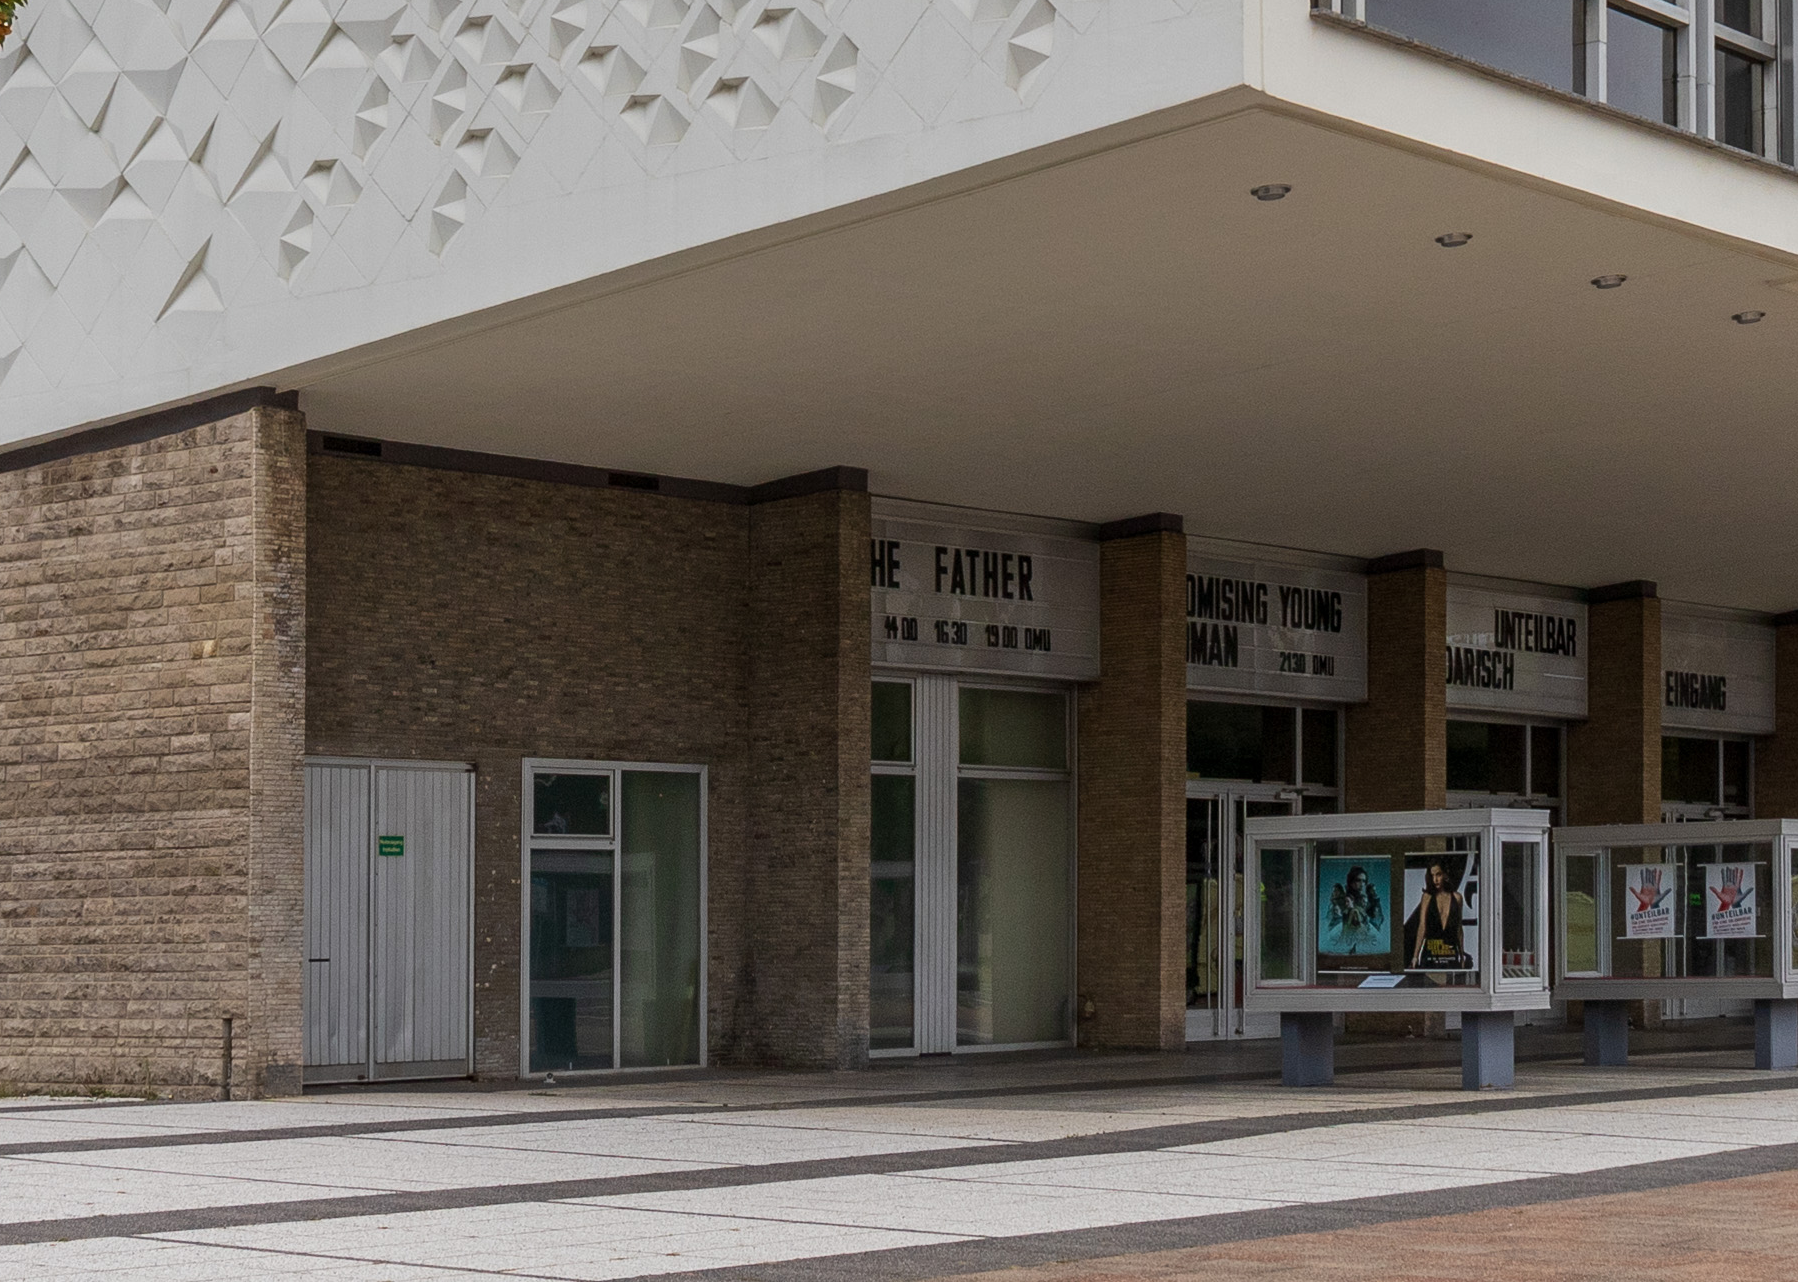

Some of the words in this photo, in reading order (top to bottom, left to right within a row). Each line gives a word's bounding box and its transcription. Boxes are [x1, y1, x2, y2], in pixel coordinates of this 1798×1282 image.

[935, 546, 1033, 601] FATHER
[1279, 585, 1343, 633] YOUNG
[1495, 608, 1577, 657] UNTEILBAR
[1187, 621, 1238, 668] MAN
[1665, 670, 1727, 712] EINGANG
[1630, 907, 1670, 921] #UNTEILBAR
[1711, 907, 1753, 921] #UNTEILBAR
